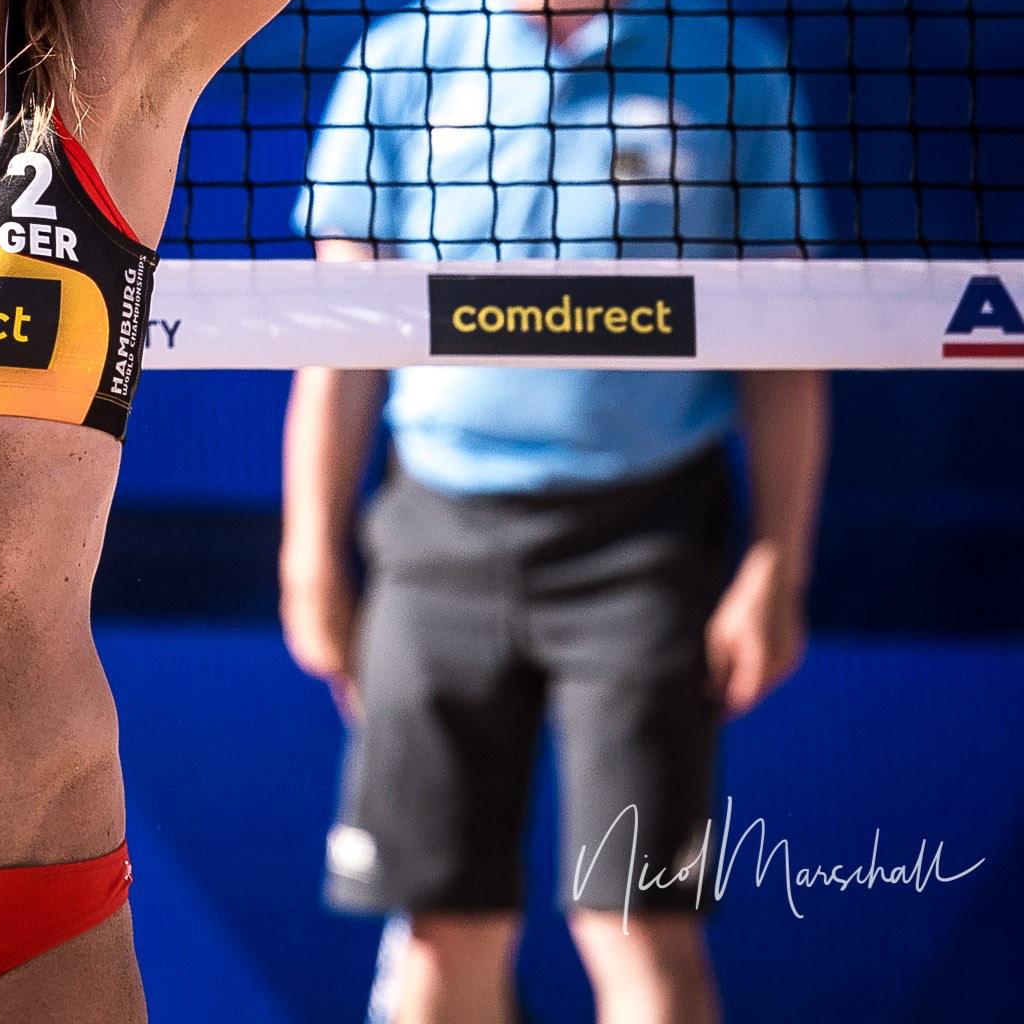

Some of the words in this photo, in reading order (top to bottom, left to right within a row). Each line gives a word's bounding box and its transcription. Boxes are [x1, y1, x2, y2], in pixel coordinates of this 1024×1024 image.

[6, 152, 58, 220] 2
[111, 268, 137, 394] HAMBURG
[122, 354, 135, 395] WORLD
[130, 254, 147, 348] CHAMPIONSHIPS
[452, 294, 673, 334] comdirect
